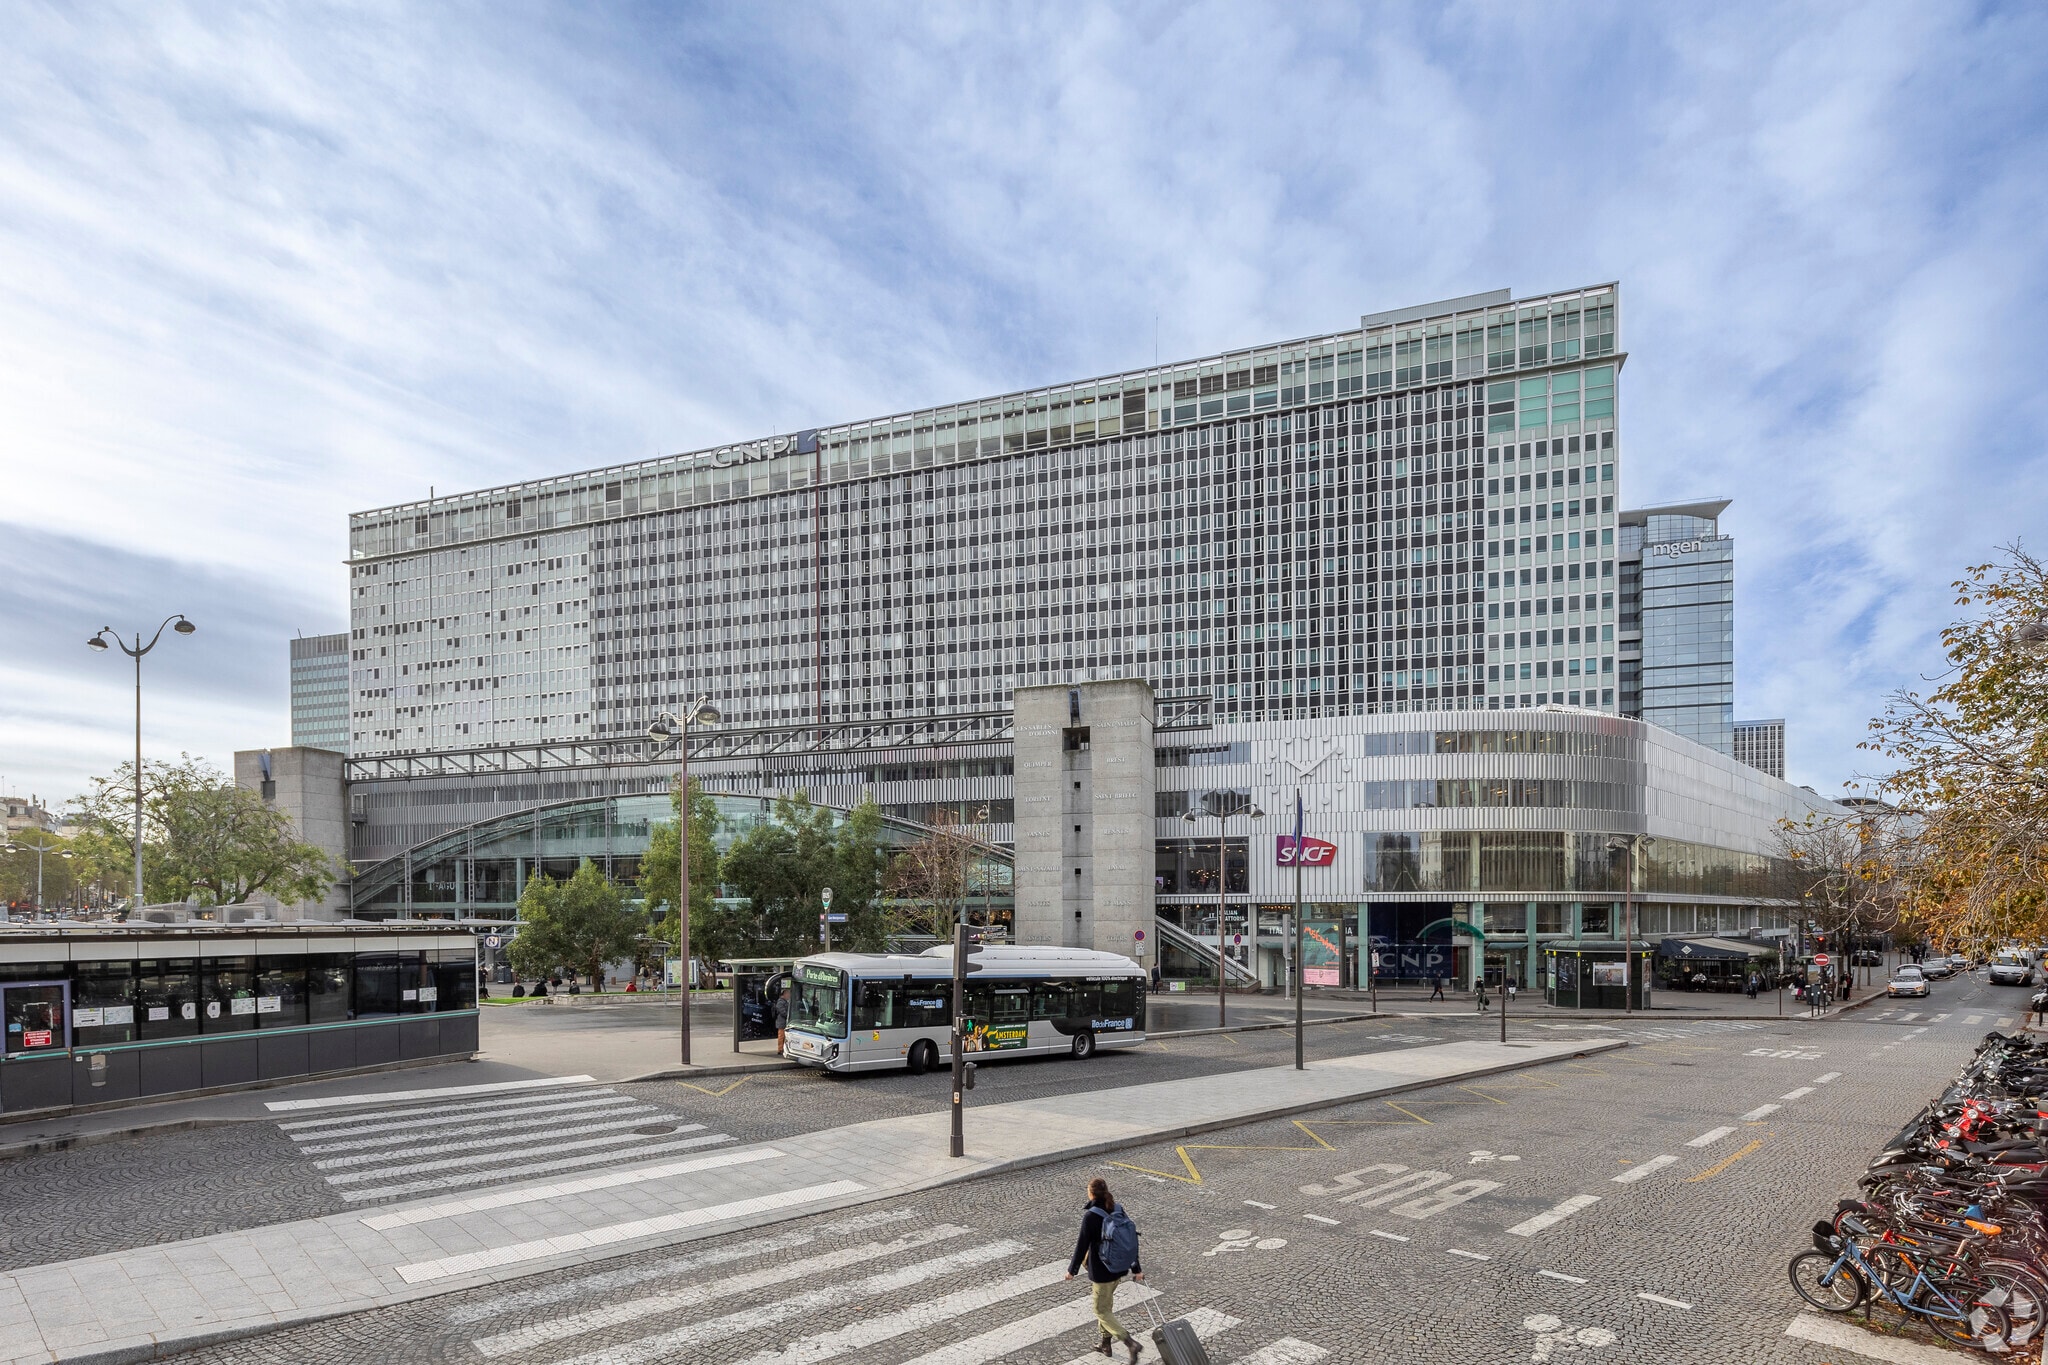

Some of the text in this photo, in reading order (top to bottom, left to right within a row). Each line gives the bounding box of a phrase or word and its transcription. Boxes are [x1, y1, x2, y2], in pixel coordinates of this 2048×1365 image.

[711, 436, 790, 468] CNP
[1653, 541, 1702, 559] mgen
[1278, 846, 1334, 862] SNCF
[1379, 953, 1444, 968] CNP
[995, 1030, 1027, 1040] AMSTERDAM
